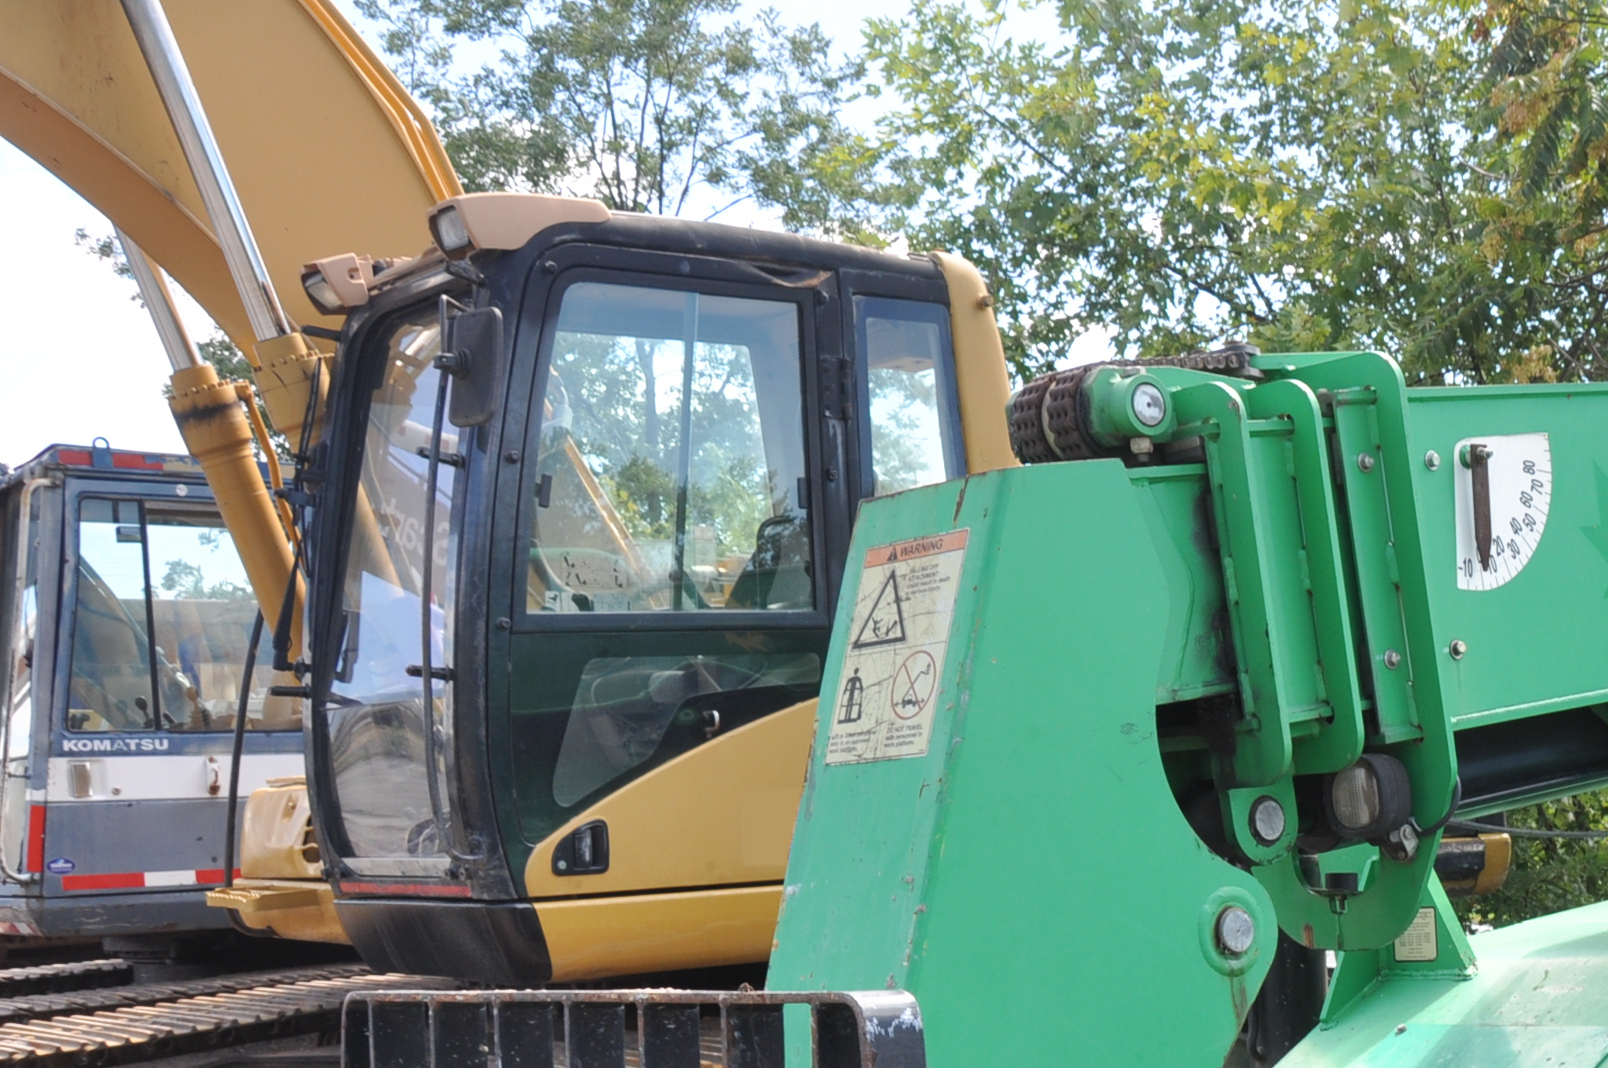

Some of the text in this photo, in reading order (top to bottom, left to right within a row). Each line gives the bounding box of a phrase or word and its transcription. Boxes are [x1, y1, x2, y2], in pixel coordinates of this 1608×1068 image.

[1523, 460, 1536, 475] 80
[1531, 478, 1544, 495] 70
[1520, 491, 1533, 509] 60
[1510, 517, 1523, 536] 40
[1522, 513, 1536, 532] 50
[900, 538, 944, 557] WARNING
[1492, 535, 1505, 556] 20
[1507, 538, 1520, 560] 30
[1458, 557, 1473, 578] -10
[62, 738, 169, 752] KOMATSU
